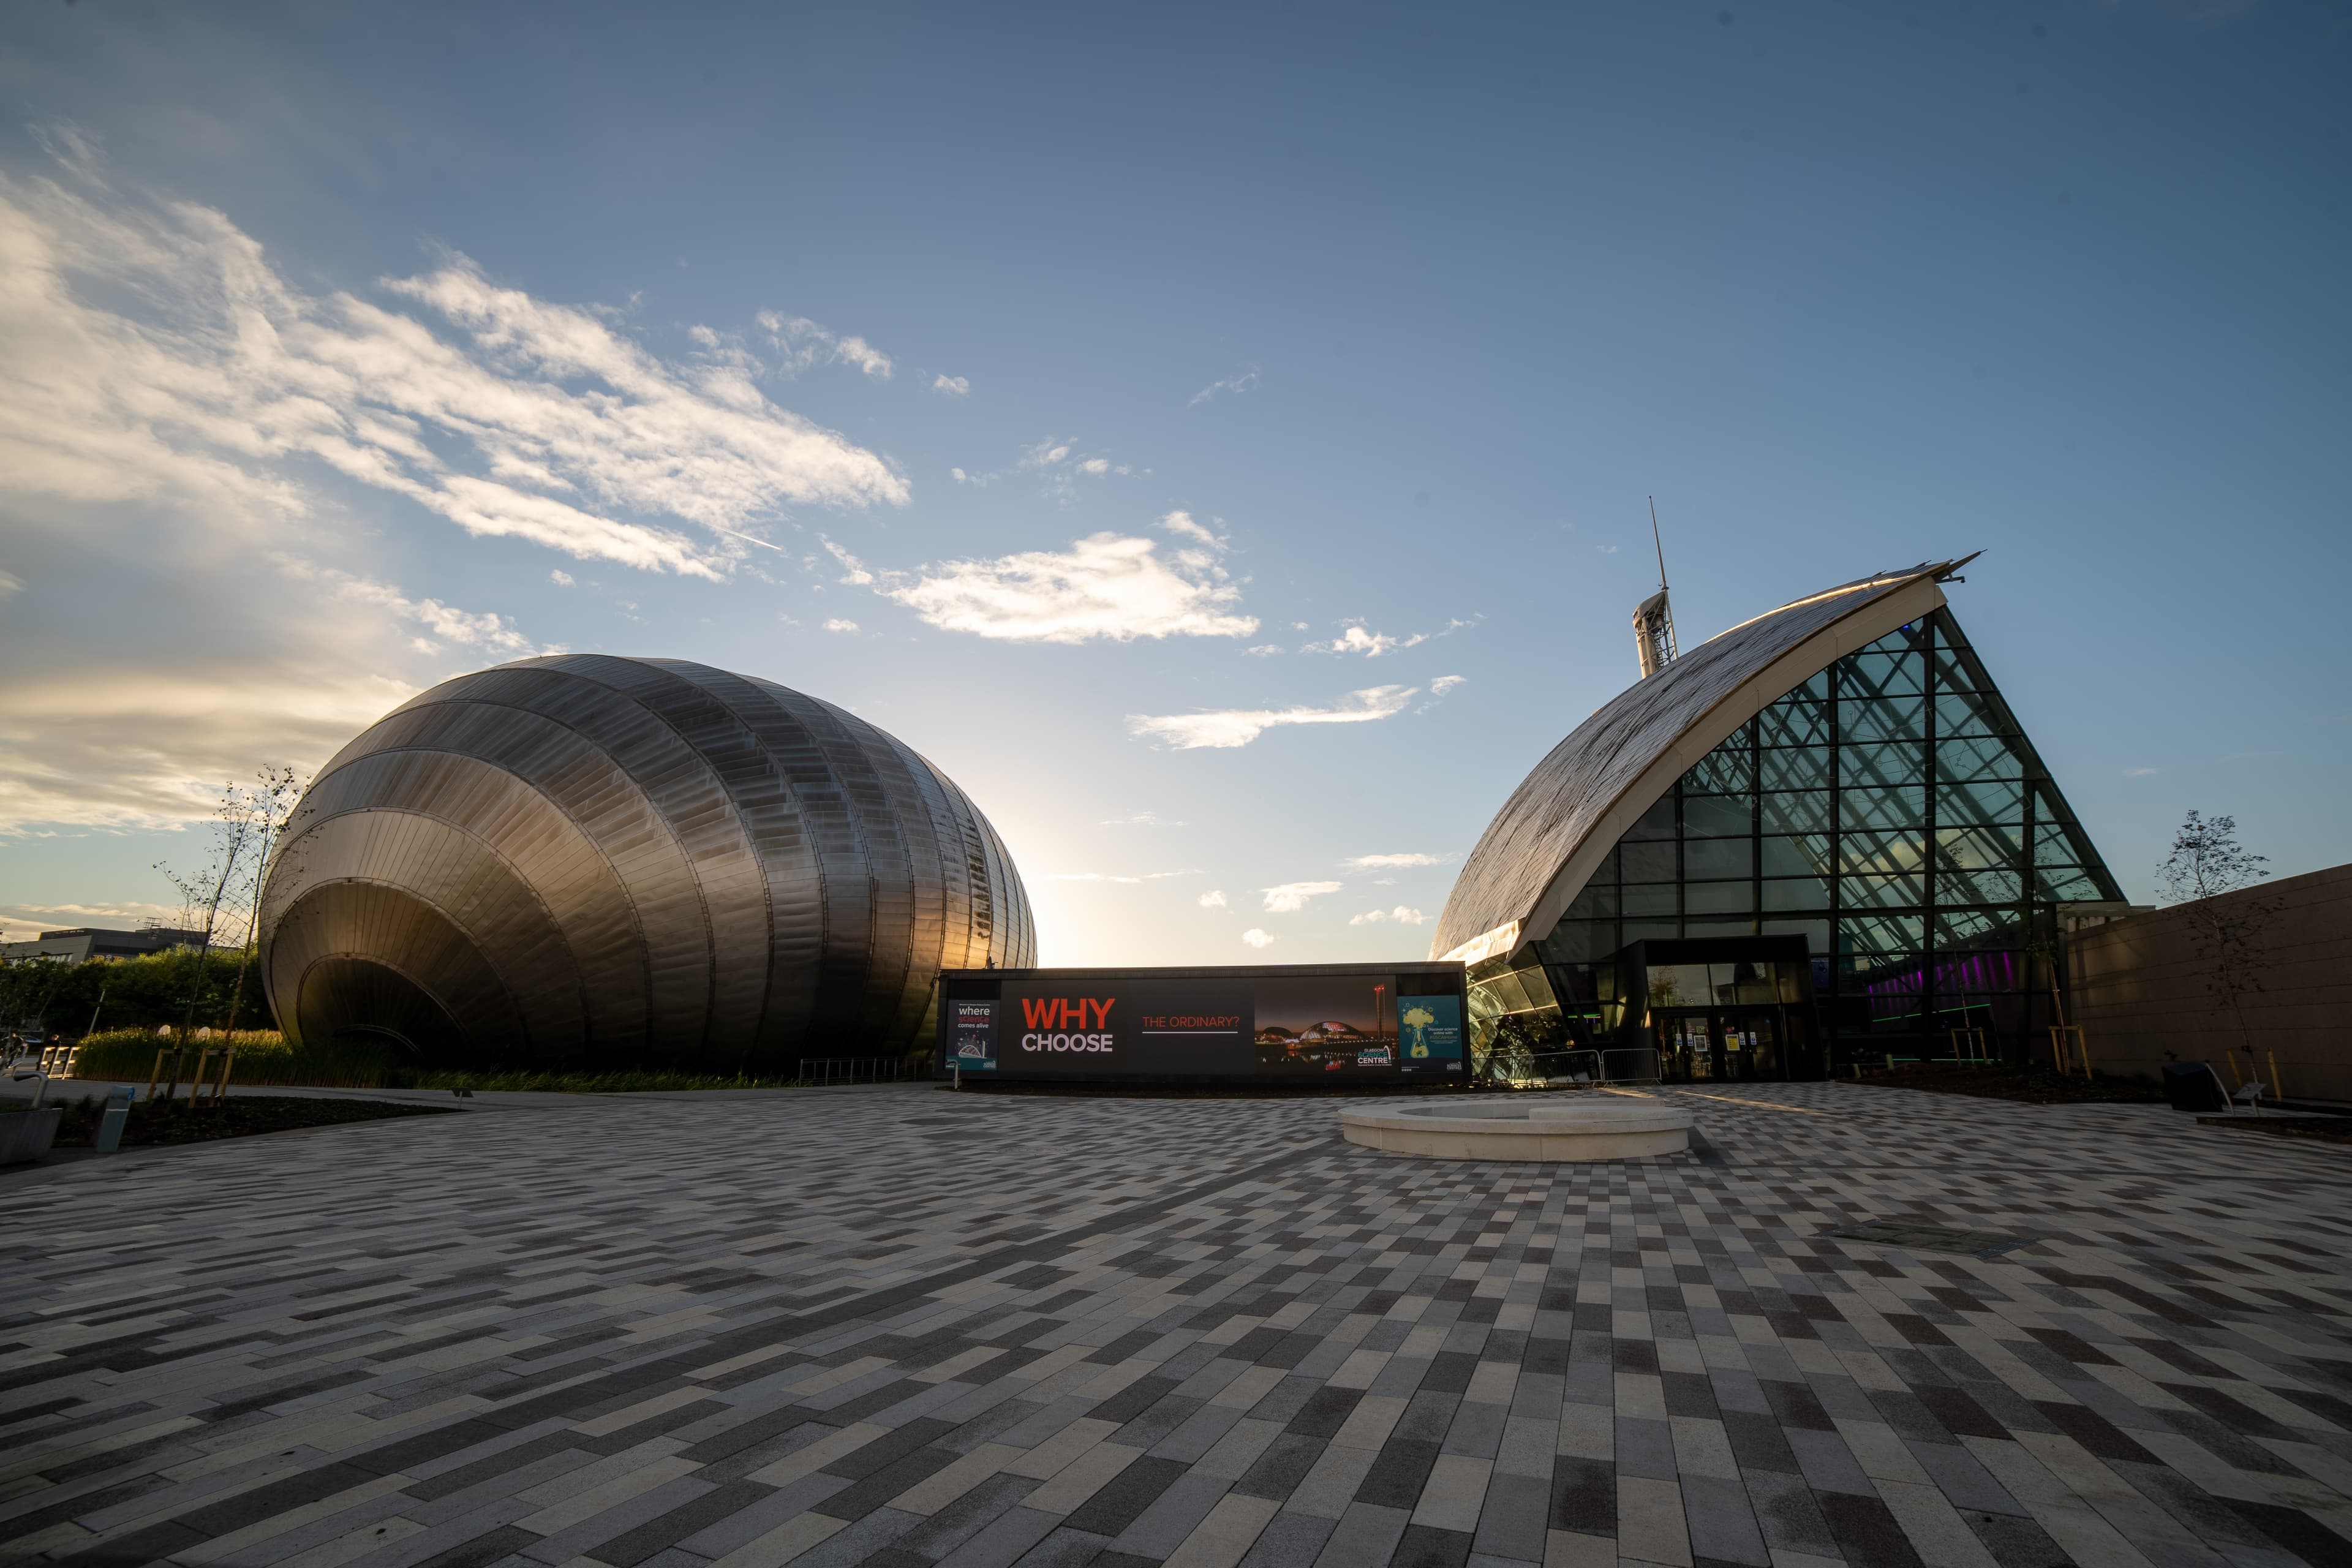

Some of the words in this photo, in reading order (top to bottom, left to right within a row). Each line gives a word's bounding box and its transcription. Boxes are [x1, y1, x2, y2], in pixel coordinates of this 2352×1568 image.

[959, 1006, 990, 1015] where
[1022, 998, 1116, 1029] WHY
[1142, 1017, 1166, 1027] THE
[1170, 1016, 1240, 1027] ORDINARY?
[1022, 1034, 1113, 1052] CHOOSE
